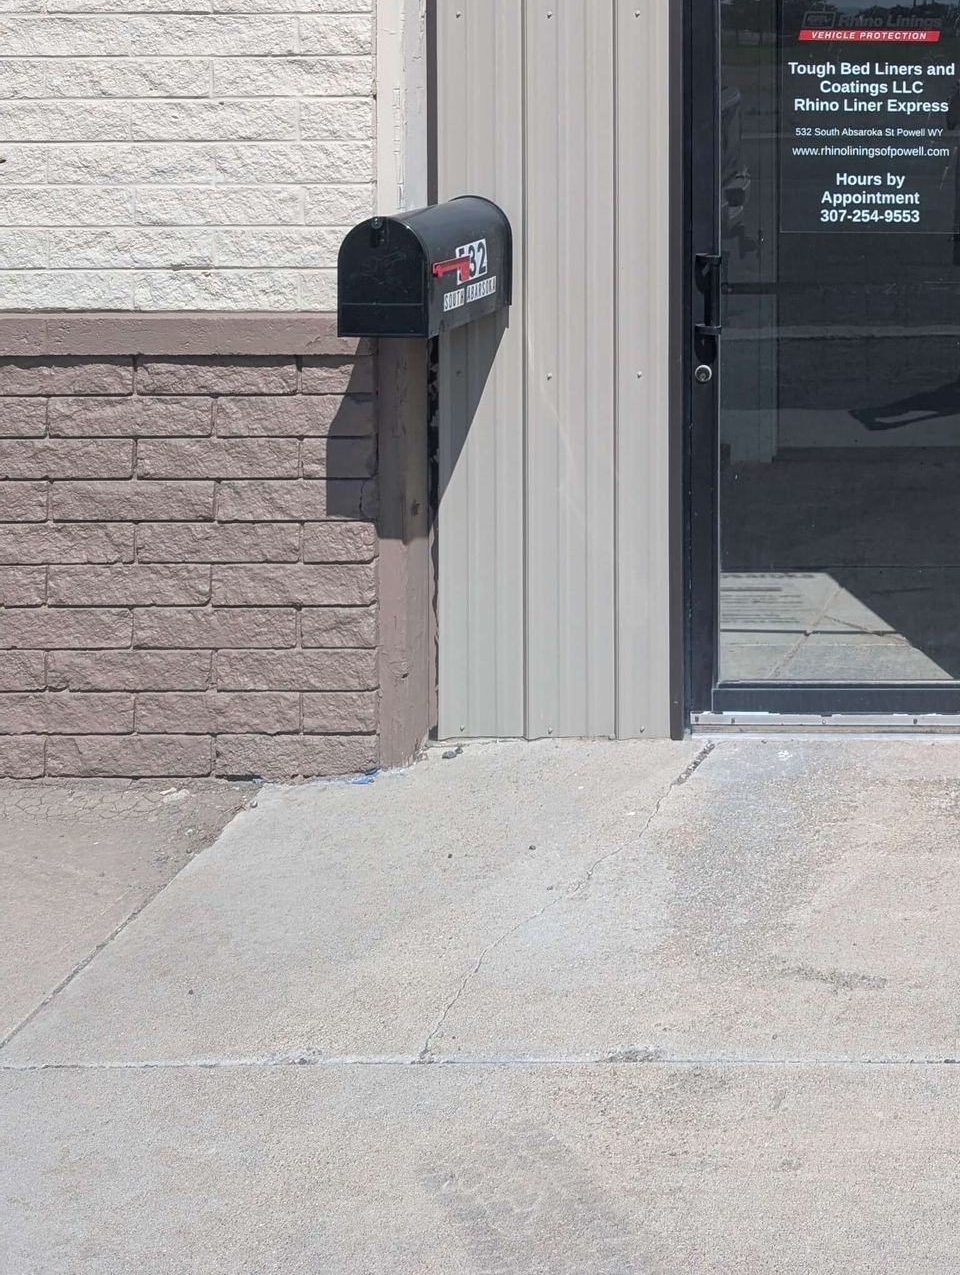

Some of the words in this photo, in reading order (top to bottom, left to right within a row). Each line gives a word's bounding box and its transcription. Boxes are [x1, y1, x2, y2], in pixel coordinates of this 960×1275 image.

[811, 31, 856, 39] VEHICLE
[859, 31, 927, 39] PROTECTION
[787, 61, 836, 78] Tough
[840, 61, 870, 75] Bed
[875, 61, 923, 76] Liners
[926, 62, 955, 76] and
[819, 80, 888, 97] Coatings
[892, 80, 924, 94] LLC
[794, 97, 840, 112] Rhino
[843, 98, 883, 112] Liner
[887, 99, 949, 115] Express
[795, 127, 812, 135] 532
[814, 127, 840, 136] South
[841, 127, 883, 136] Absaroka
[885, 128, 895, 136] St
[896, 128, 926, 136] Powell
[927, 128, 944, 136] WY
[791, 145, 950, 159] www.rhinoliningsofpowell.com
[836, 172, 882, 186] Hours
[886, 172, 906, 189] by
[821, 190, 920, 208] Appointment
[820, 209, 920, 223] 307-254-9553
[444, 290, 465, 310] SOUTH
